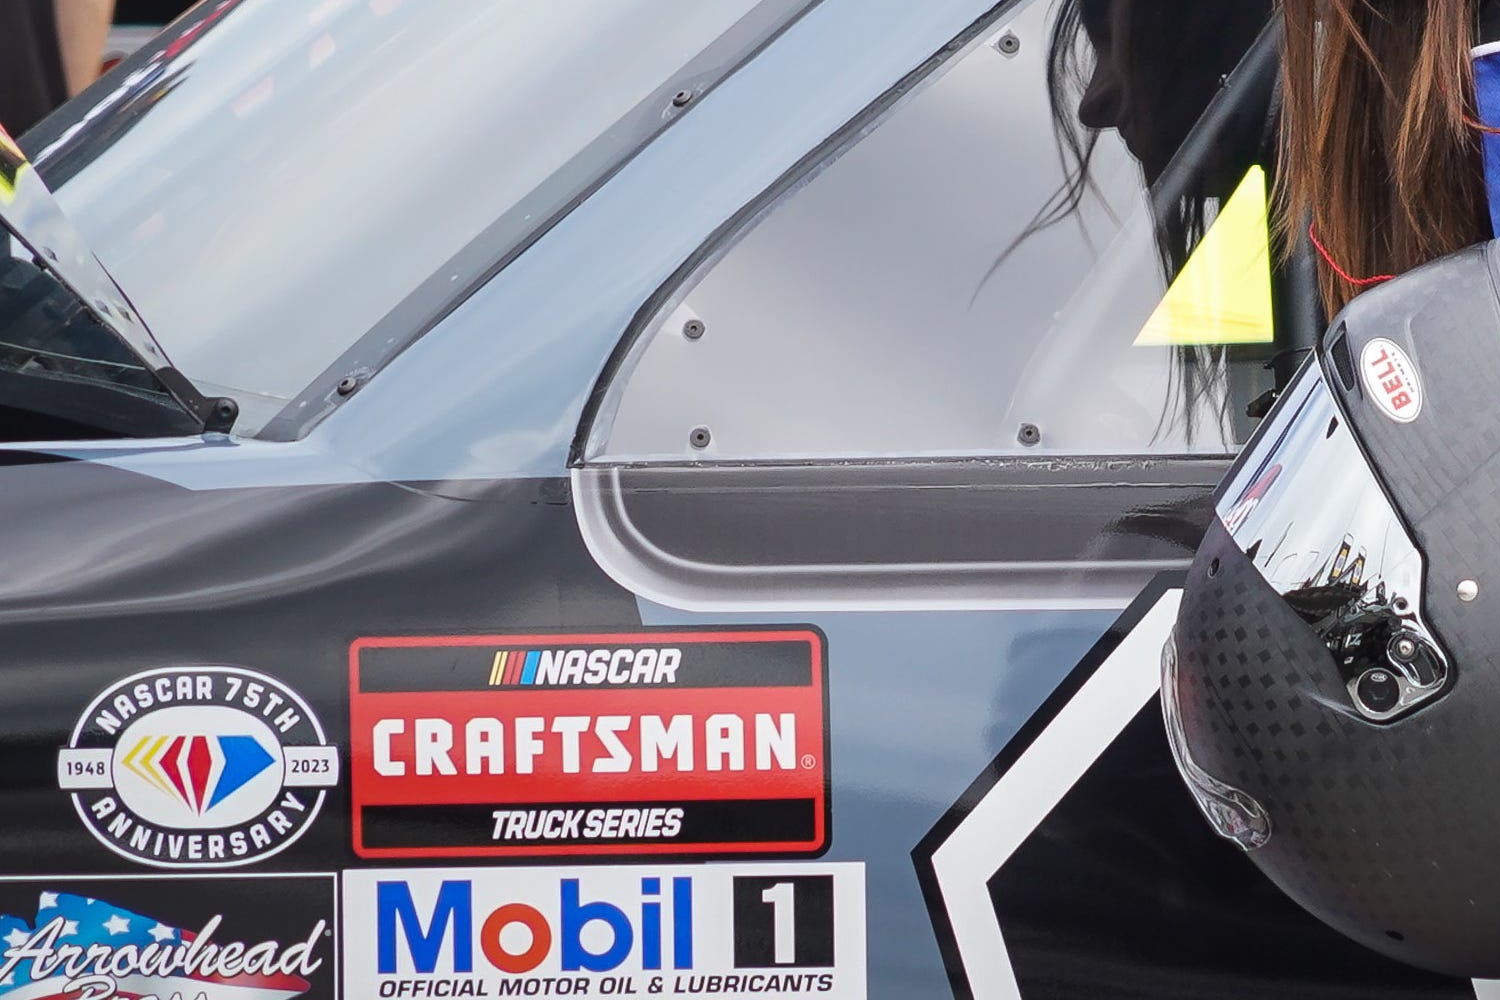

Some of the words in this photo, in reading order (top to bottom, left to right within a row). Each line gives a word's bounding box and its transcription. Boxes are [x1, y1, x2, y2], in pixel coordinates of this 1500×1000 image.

[1371, 348, 1413, 410] BELL
[534, 649, 682, 685] NASCAR
[95, 675, 213, 736] NASCAR
[226, 676, 301, 733] 75TH
[66, 761, 105, 776] 1948
[291, 758, 330, 774] 2023
[372, 713, 797, 777] CRAFTSMAN
[91, 792, 306, 860] ANNIVERSARY
[491, 810, 584, 839] TRUCK
[583, 808, 684, 838] SERIES
[1, 914, 326, 981] Arrowhead
[377, 877, 694, 974] Mobil
[761, 882, 797, 965] 1
[379, 979, 488, 998] OFFICIAL
[499, 977, 590, 997] MOTOR
[599, 976, 637, 995] OIL
[648, 975, 664, 993] &
[673, 974, 834, 994] LUBRICANTS
